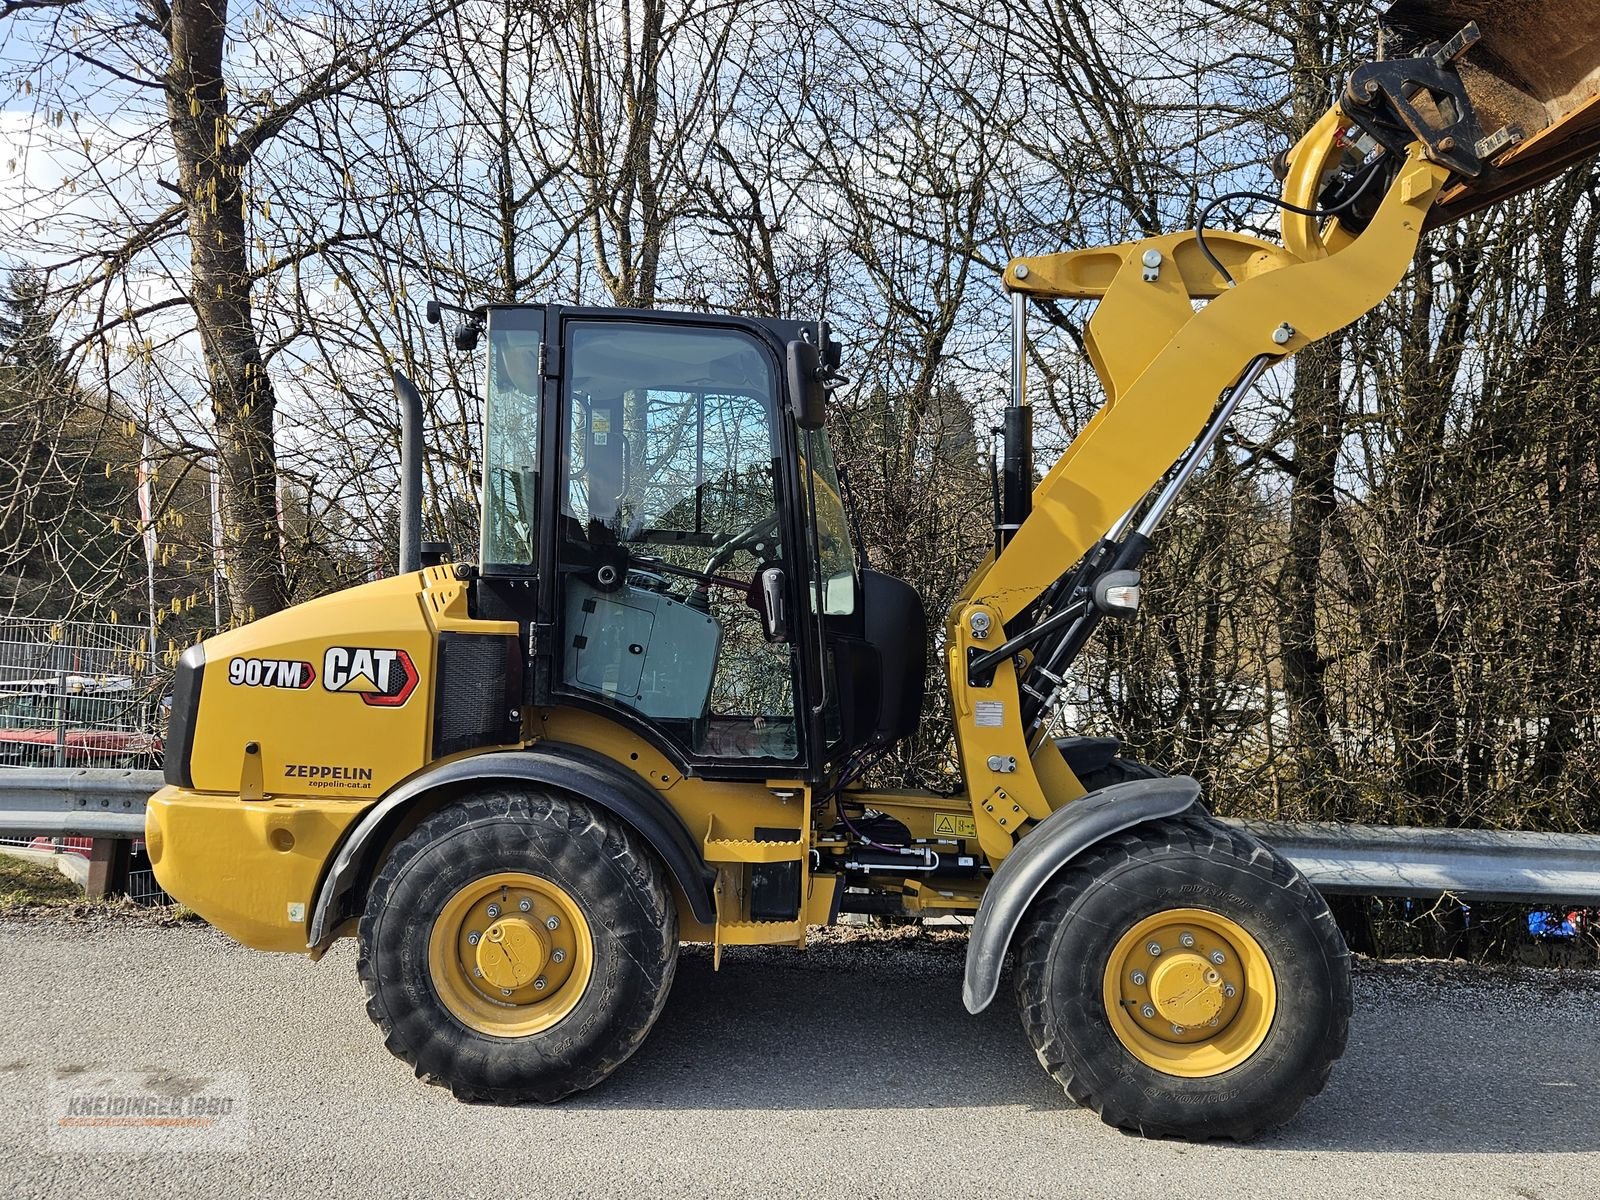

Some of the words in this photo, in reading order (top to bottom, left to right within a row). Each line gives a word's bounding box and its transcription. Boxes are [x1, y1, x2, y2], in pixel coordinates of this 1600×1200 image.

[230, 658, 301, 688] 907M
[324, 648, 397, 693] CAT
[284, 765, 372, 780] ZEPPELIN
[308, 780, 371, 789] zeppelin-cat.at
